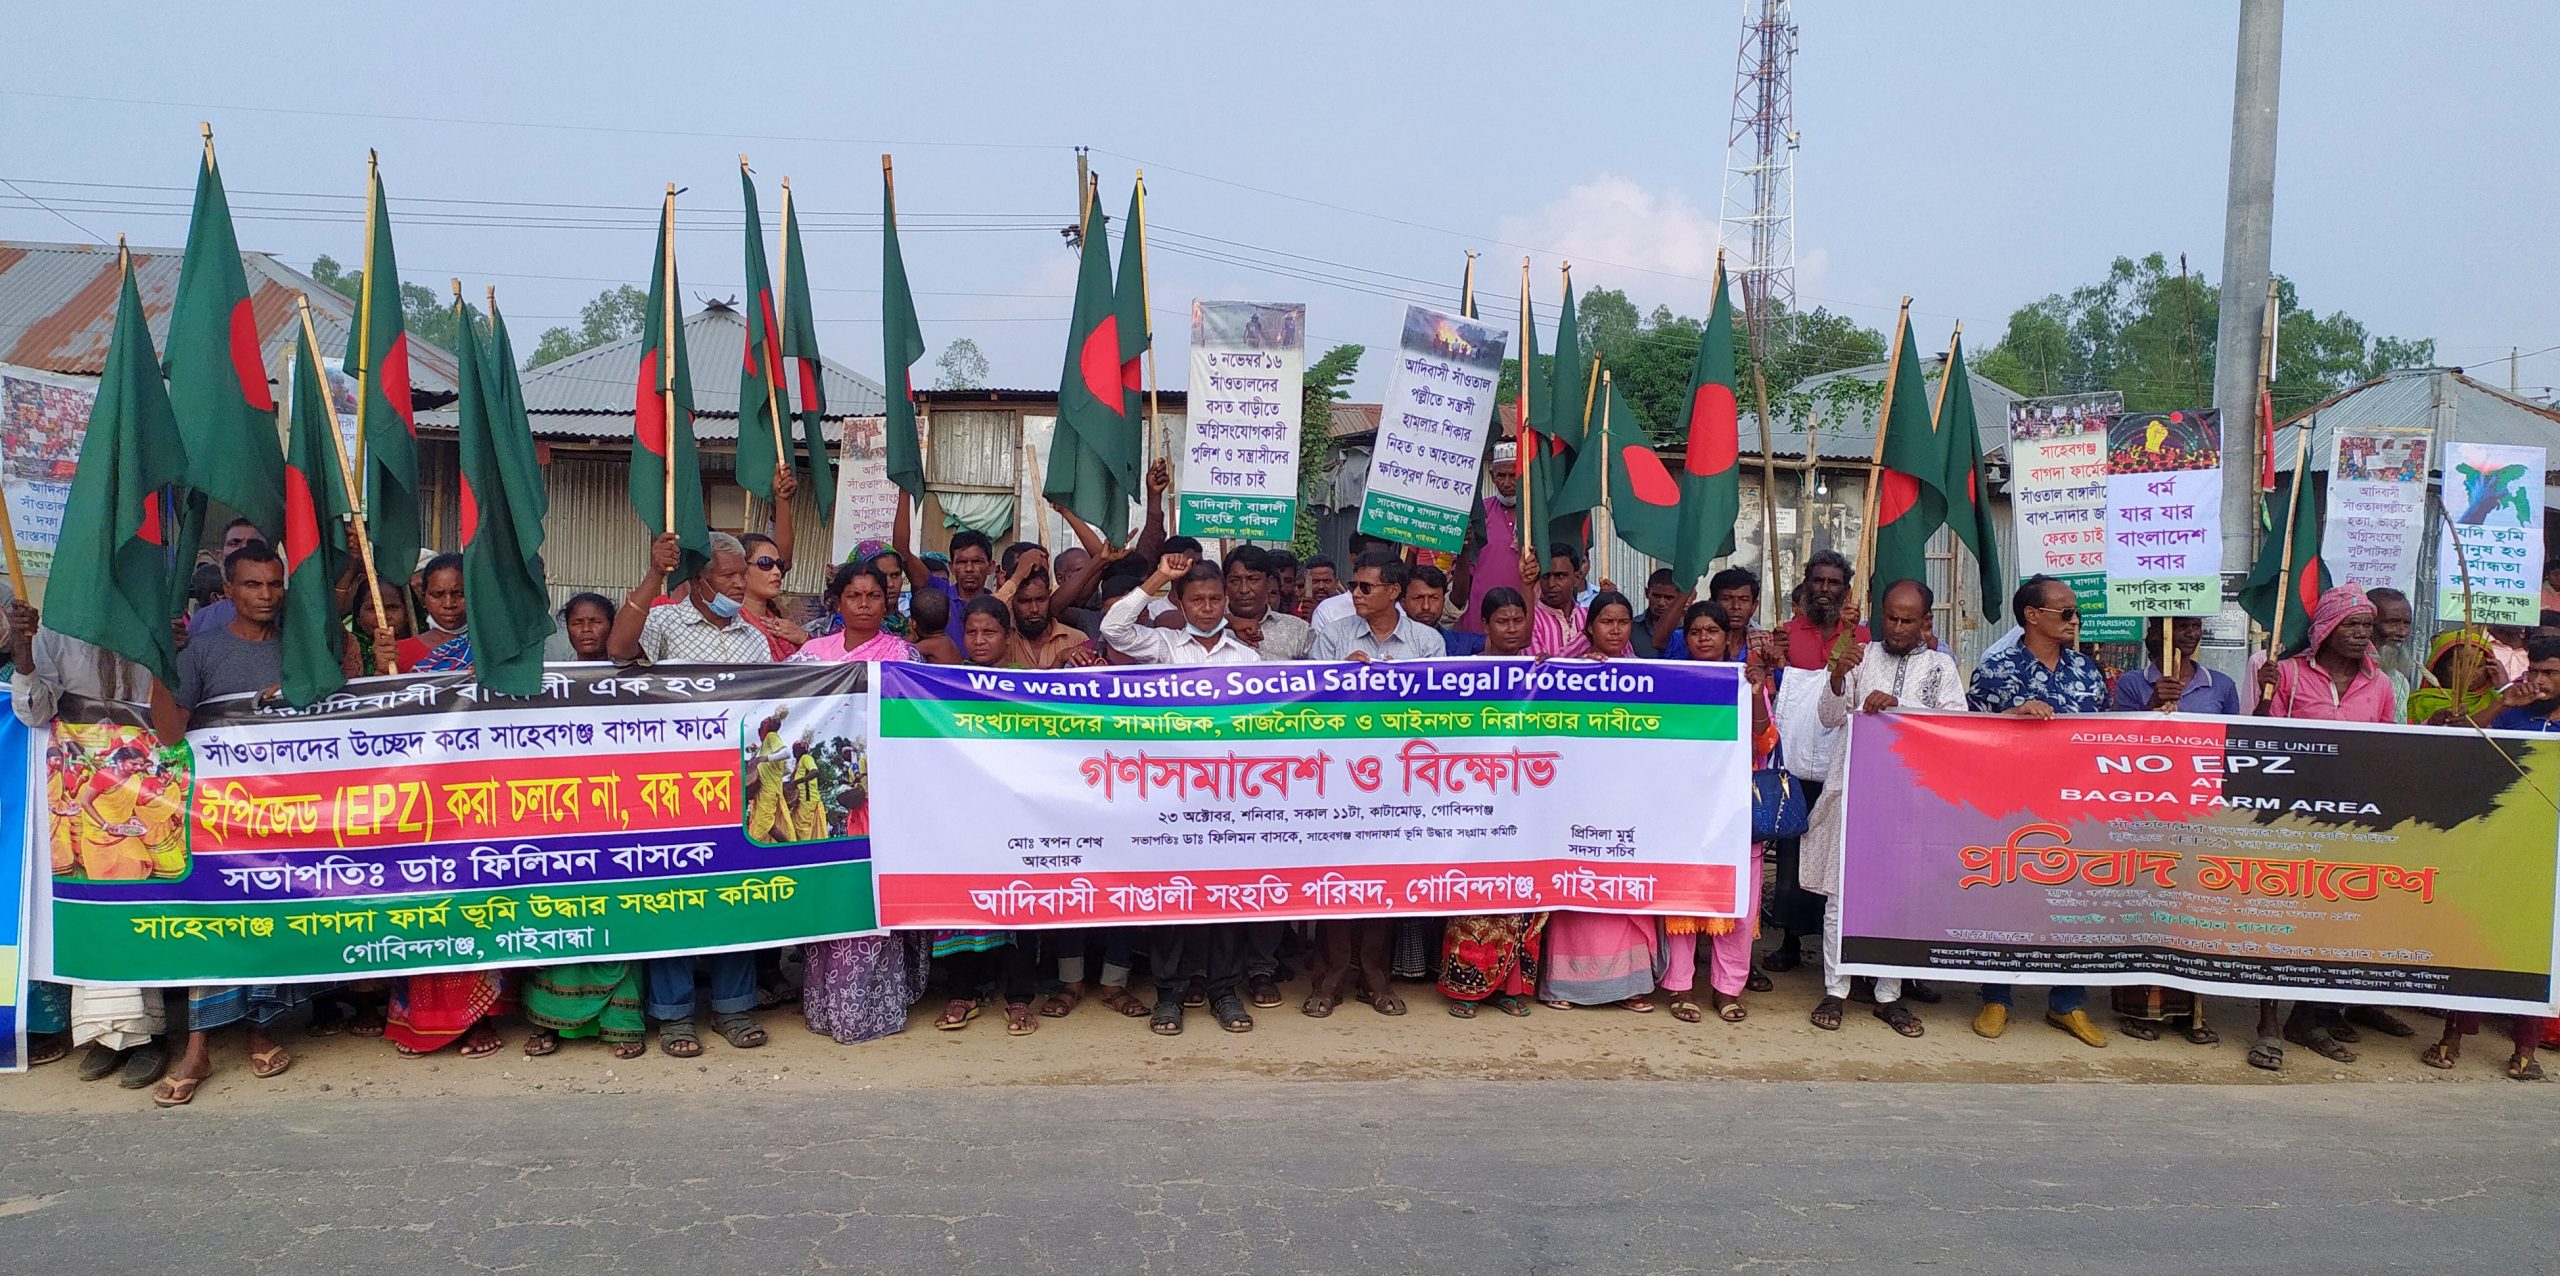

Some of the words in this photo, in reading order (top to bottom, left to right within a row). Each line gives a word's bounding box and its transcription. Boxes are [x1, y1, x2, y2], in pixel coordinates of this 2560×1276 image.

[1208, 354, 1217, 368] ৬
[1210, 371, 1279, 393] সাঁওতালদের
[1405, 357, 1450, 383] আদিবাসী
[1452, 366, 1492, 393] সাঁওতাল
[1411, 386, 1446, 408] পল্লীতে
[1206, 400, 1235, 416] বসত
[1239, 397, 1280, 420] বাড়ীতে
[1196, 419, 1288, 443] অগ্নিসংযোগকারী
[1403, 412, 1440, 434] হামলার
[1442, 419, 1472, 443] শিকার
[1191, 442, 1220, 466] পুলিশ
[1224, 450, 1233, 462] ও
[1237, 444, 1290, 466] সন্ত্রাসীদের
[1386, 432, 1414, 455] নিহত
[1417, 445, 1425, 457] ও
[1429, 445, 1476, 470] আহতদের
[2039, 441, 2097, 460] সাহেবগঞ্জ
[1210, 466, 1242, 488] বিচার
[1245, 469, 1268, 490] চাই
[1377, 460, 1425, 489] ক্ষতিপূরণ
[1426, 470, 1451, 491] দিতে
[1453, 479, 1473, 497] হবে
[2030, 465, 2065, 483] বাগদা
[2019, 486, 2064, 506] সাঁওতাল
[2147, 474, 2178, 497] ধর্ম
[1187, 497, 1243, 513] আদিবাসী
[2119, 505, 2154, 523] যার
[2159, 503, 2195, 521] যার
[1194, 511, 1234, 525] সংহতি
[1238, 512, 1280, 527] পরিষদ
[2025, 507, 2089, 526] বাপ-দাদার
[2042, 529, 2080, 548] ফেরত
[2082, 526, 2106, 545] চাই
[2115, 526, 2208, 548] বাংলাদেশ
[2456, 525, 2486, 541] যদি
[2492, 528, 2527, 545] তুমি
[2044, 550, 2080, 570] দিতে
[2080, 551, 2104, 569] হবে
[2135, 552, 2187, 571] সবার
[2500, 545, 2528, 559] হও
[2114, 579, 2174, 597] নাগরিক
[2176, 579, 2207, 597] মঞ্চ
[2492, 577, 2527, 590] দাও
[2128, 596, 2193, 613] গাইবান্ধা
[589, 676, 654, 698] এক
[967, 671, 1016, 694] We
[1022, 675, 1100, 699] want
[1108, 672, 1221, 702] Justice,
[1226, 669, 1317, 697] Social
[1323, 667, 1420, 697] Safety,
[1427, 667, 1502, 697] Legal
[1508, 667, 1655, 695] Protection
[953, 710, 1104, 738] সংখ্যালঘুদের
[1112, 708, 1222, 738] সামাজিক,
[1231, 706, 1347, 735] রাজনৈতিক
[1355, 714, 1374, 731] ও
[1380, 707, 1475, 733] আইনগত
[1480, 706, 1579, 733] নিরাপত্তার
[1587, 707, 1663, 734] দাবীতে
[202, 734, 341, 769] সাঁওতালদের
[348, 727, 427, 760] উচ্ছেদ
[432, 726, 482, 752] করে
[488, 719, 595, 748] সাহেবগঞ্জ
[602, 715, 667, 746] বাগদা
[672, 708, 730, 742] ফার্মে
[2070, 732, 2249, 749] ADIBASI-BANGALEE
[2255, 739, 2279, 750] BE
[2285, 742, 2339, 753] UNITE
[1079, 746, 1336, 803] গণসমাবেশ
[1346, 753, 1385, 793] ও
[1396, 738, 1564, 798] বিক্ষোভ
[2095, 754, 2174, 774] NO
[2191, 754, 2296, 774] EPZ
[2191, 776, 2228, 789] AT
[199, 780, 323, 847] ইপিজেড
[332, 779, 434, 848] (EPZ)
[442, 774, 500, 828] করা
[506, 775, 583, 824] চলবে
[587, 768, 630, 831] না,
[636, 770, 683, 820] বন্ধ
[688, 769, 735, 815] কর
[2060, 788, 2179, 804] BAGDA
[2190, 793, 2281, 810] FARM
[2289, 799, 2382, 815] AREA
[1158, 811, 1178, 825] ২৩
[1293, 806, 1328, 821] সকাল
[1431, 801, 1494, 817] গোবিন্দগঞ্জ
[1038, 836, 1071, 849] স্বপন
[1076, 835, 1105, 849] শেখ
[1208, 828, 1255, 845] ফিলিমন
[1404, 826, 1424, 841] ভূমি
[1426, 825, 1454, 840] উদ্ধার
[1490, 824, 1518, 838] কমিটি
[1569, 843, 1602, 859] সদস্য
[1605, 842, 1636, 859] সচিব
[217, 853, 385, 895] সভাপতিঃ
[396, 853, 457, 886] ডাঃ
[467, 845, 602, 883] ফিলিমন
[607, 840, 717, 873] বাসকে
[1958, 823, 2182, 890] প্রতিবাদ
[2196, 854, 2440, 903] সমাবেশ
[968, 878, 1099, 918] আদিবাসী
[1107, 875, 1199, 915] বাঙালী
[1204, 874, 1293, 912] সংহতি
[1300, 871, 1395, 910] পরিষদ,
[1405, 868, 1543, 905] গোবিন্দগঞ্জ,
[1552, 865, 1658, 903] গাইবান্ধা
[130, 913, 276, 942] সাহেবগঞ্জ
[285, 907, 378, 936] বাগদা
[385, 898, 453, 932] ফার্ম
[458, 895, 519, 931] ভূমি
[525, 892, 609, 919] উদ্ধার
[618, 887, 708, 915] সংগ্রাম
[717, 875, 798, 908] কমিটি
[342, 934, 485, 964] গোবিন্দগঞ্জ,
[495, 925, 597, 955] গাইবান্ধা
